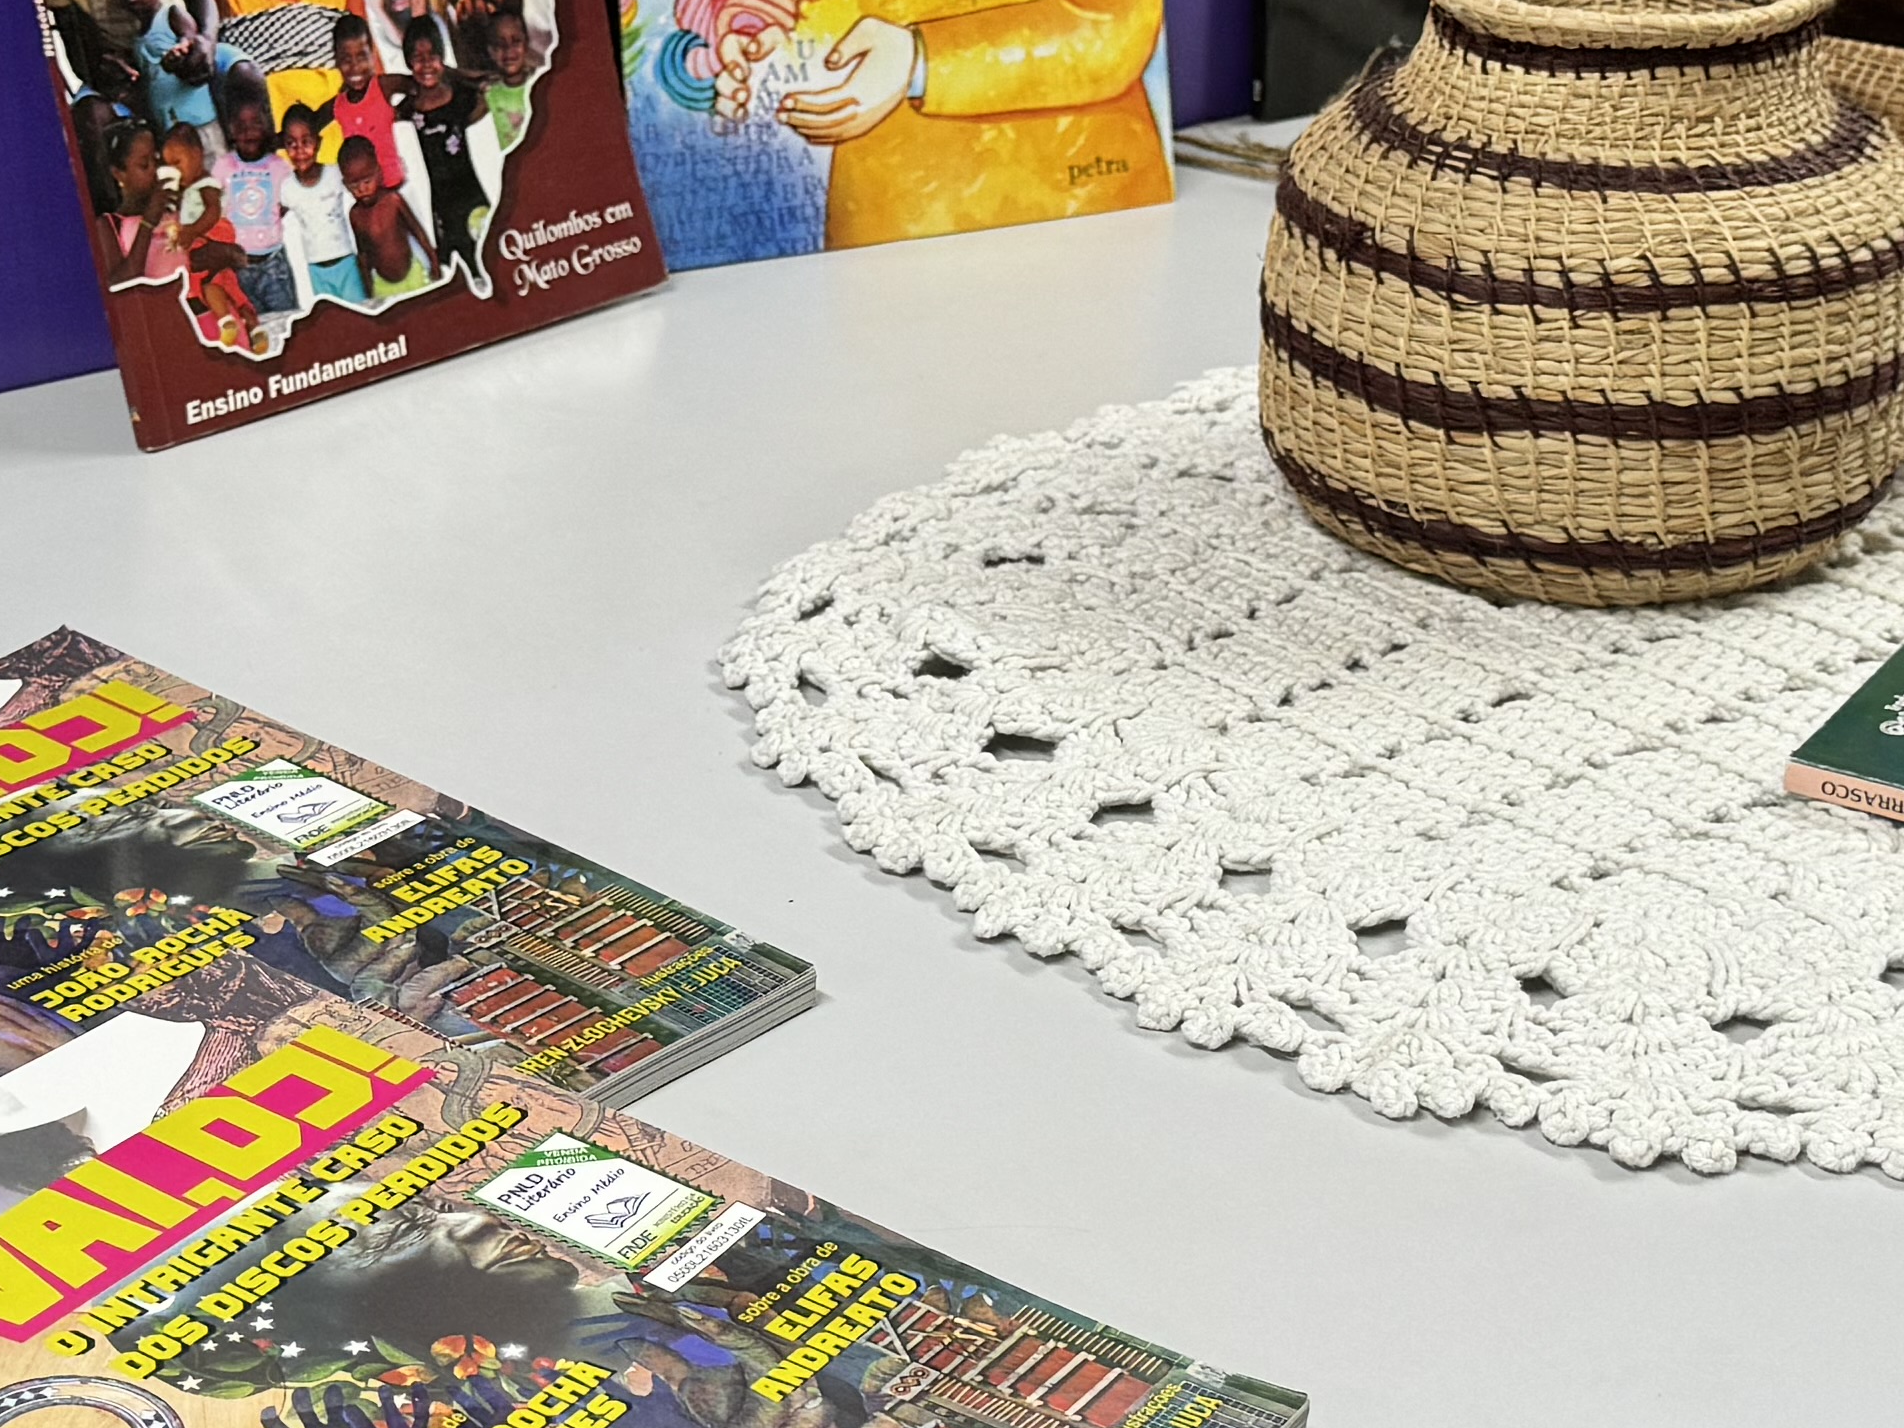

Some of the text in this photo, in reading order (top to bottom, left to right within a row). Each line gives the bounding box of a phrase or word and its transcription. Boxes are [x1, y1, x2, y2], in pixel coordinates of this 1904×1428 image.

[1068, 156, 1129, 185] petra
[498, 200, 633, 260] Quilombos em
[513, 233, 642, 296] Mato Grosso
[186, 334, 408, 425] Ensino Fundamental
[68, 741, 173, 788] CASO
[80, 735, 261, 816] PERDIDOS
[212, 785, 256, 806] PNLD
[224, 782, 283, 811] Literário
[295, 824, 331, 844] FNDE
[372, 835, 477, 892] sobre obra de
[360, 857, 534, 945] ANDREATO
[390, 844, 506, 906] ELIFAS
[6, 934, 125, 992] uma história de
[28, 905, 259, 1011] JOÃO ROCHA
[55, 929, 261, 1025] RODRIGUES
[640, 945, 714, 988] ilustrações
[567, 985, 684, 1053] ZLOCHEVSKY
[497, 1172, 544, 1206] PNLD
[514, 1167, 577, 1211] Literário
[553, 1167, 625, 1224] Ensino Médio
[47, 1114, 423, 1357] O INTRIGANTE CASO
[109, 1100, 529, 1380] DOS DISCOS PERDIDOS
[617, 1230, 658, 1260] FNDE
[737, 1239, 839, 1325] sobre obra de
[762, 1253, 882, 1345] ELIFAS
[750, 1272, 920, 1404] ANDREATO
